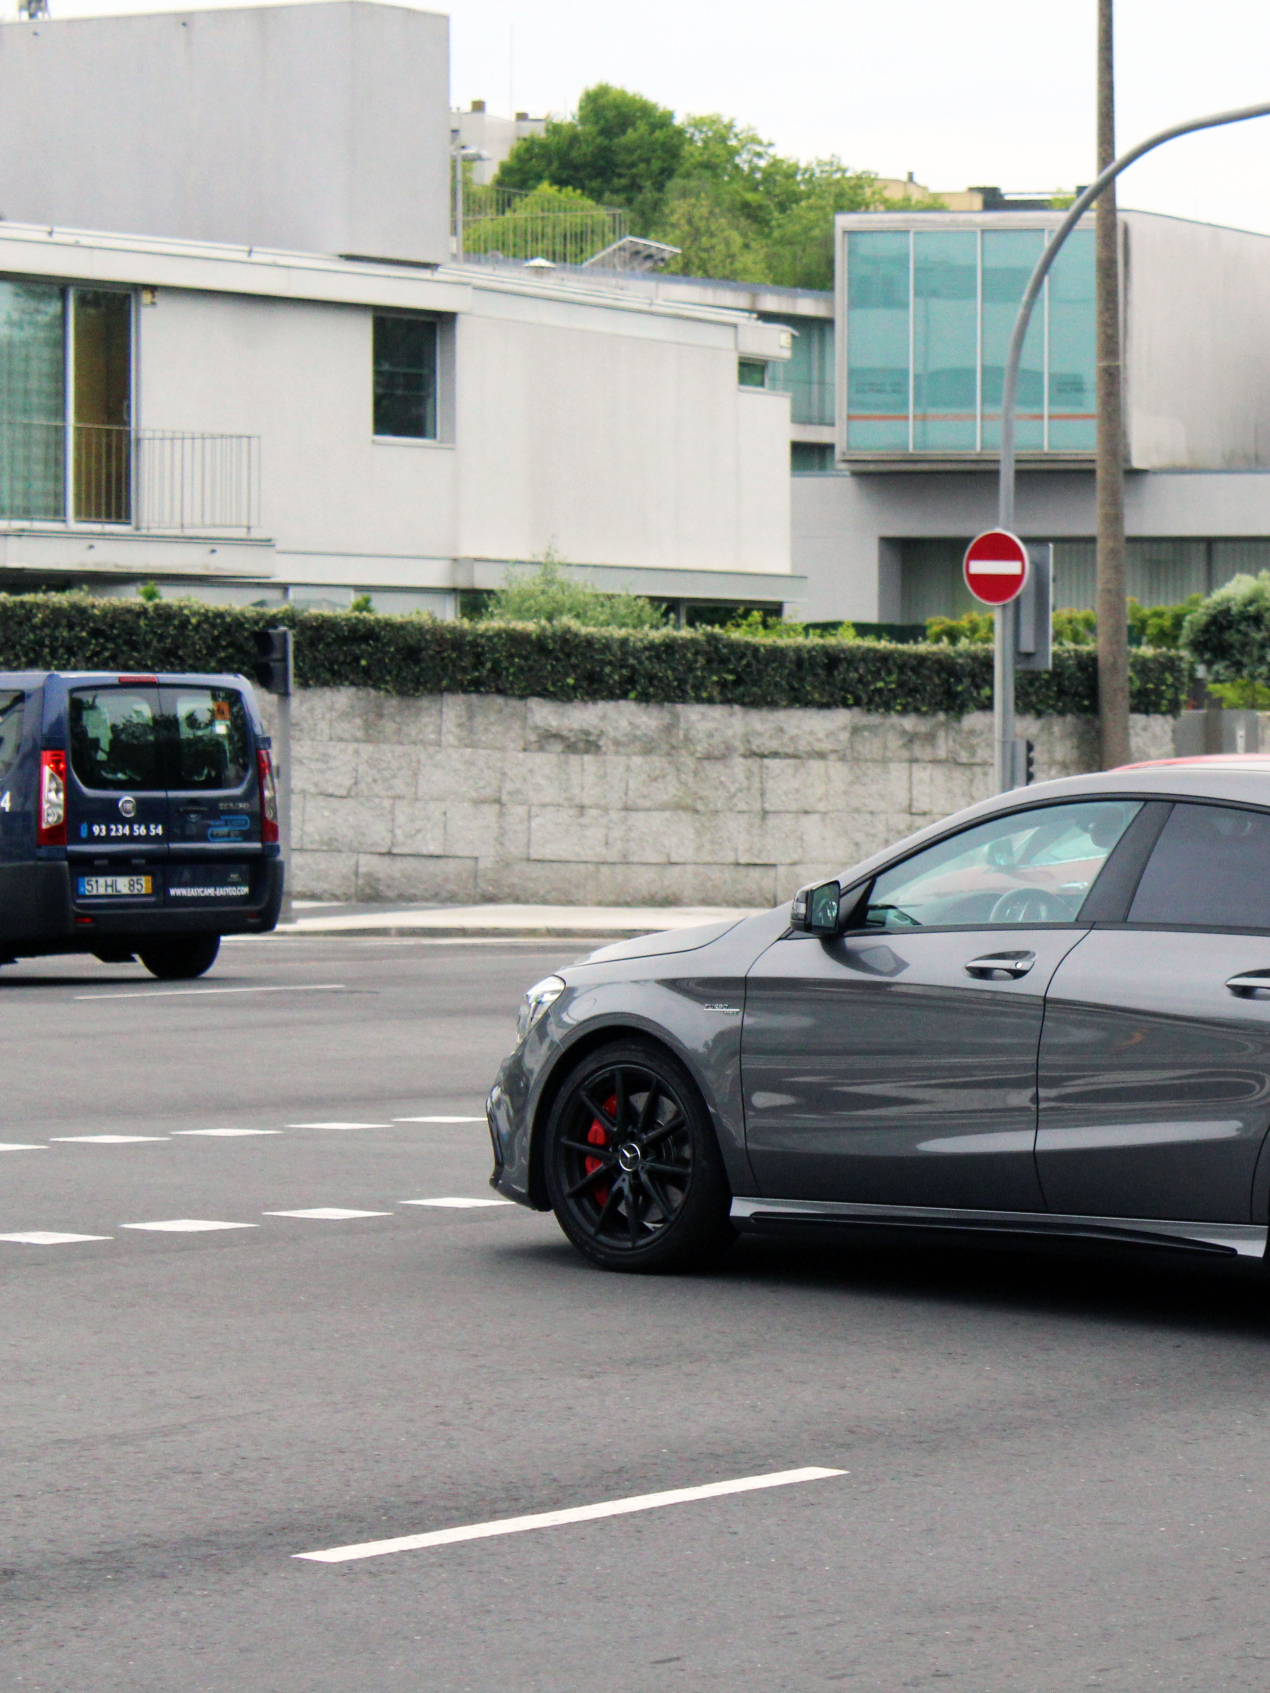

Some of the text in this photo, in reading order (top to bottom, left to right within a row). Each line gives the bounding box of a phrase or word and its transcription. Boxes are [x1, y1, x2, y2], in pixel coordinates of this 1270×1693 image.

[92, 824, 163, 837] 93 234 56 54
